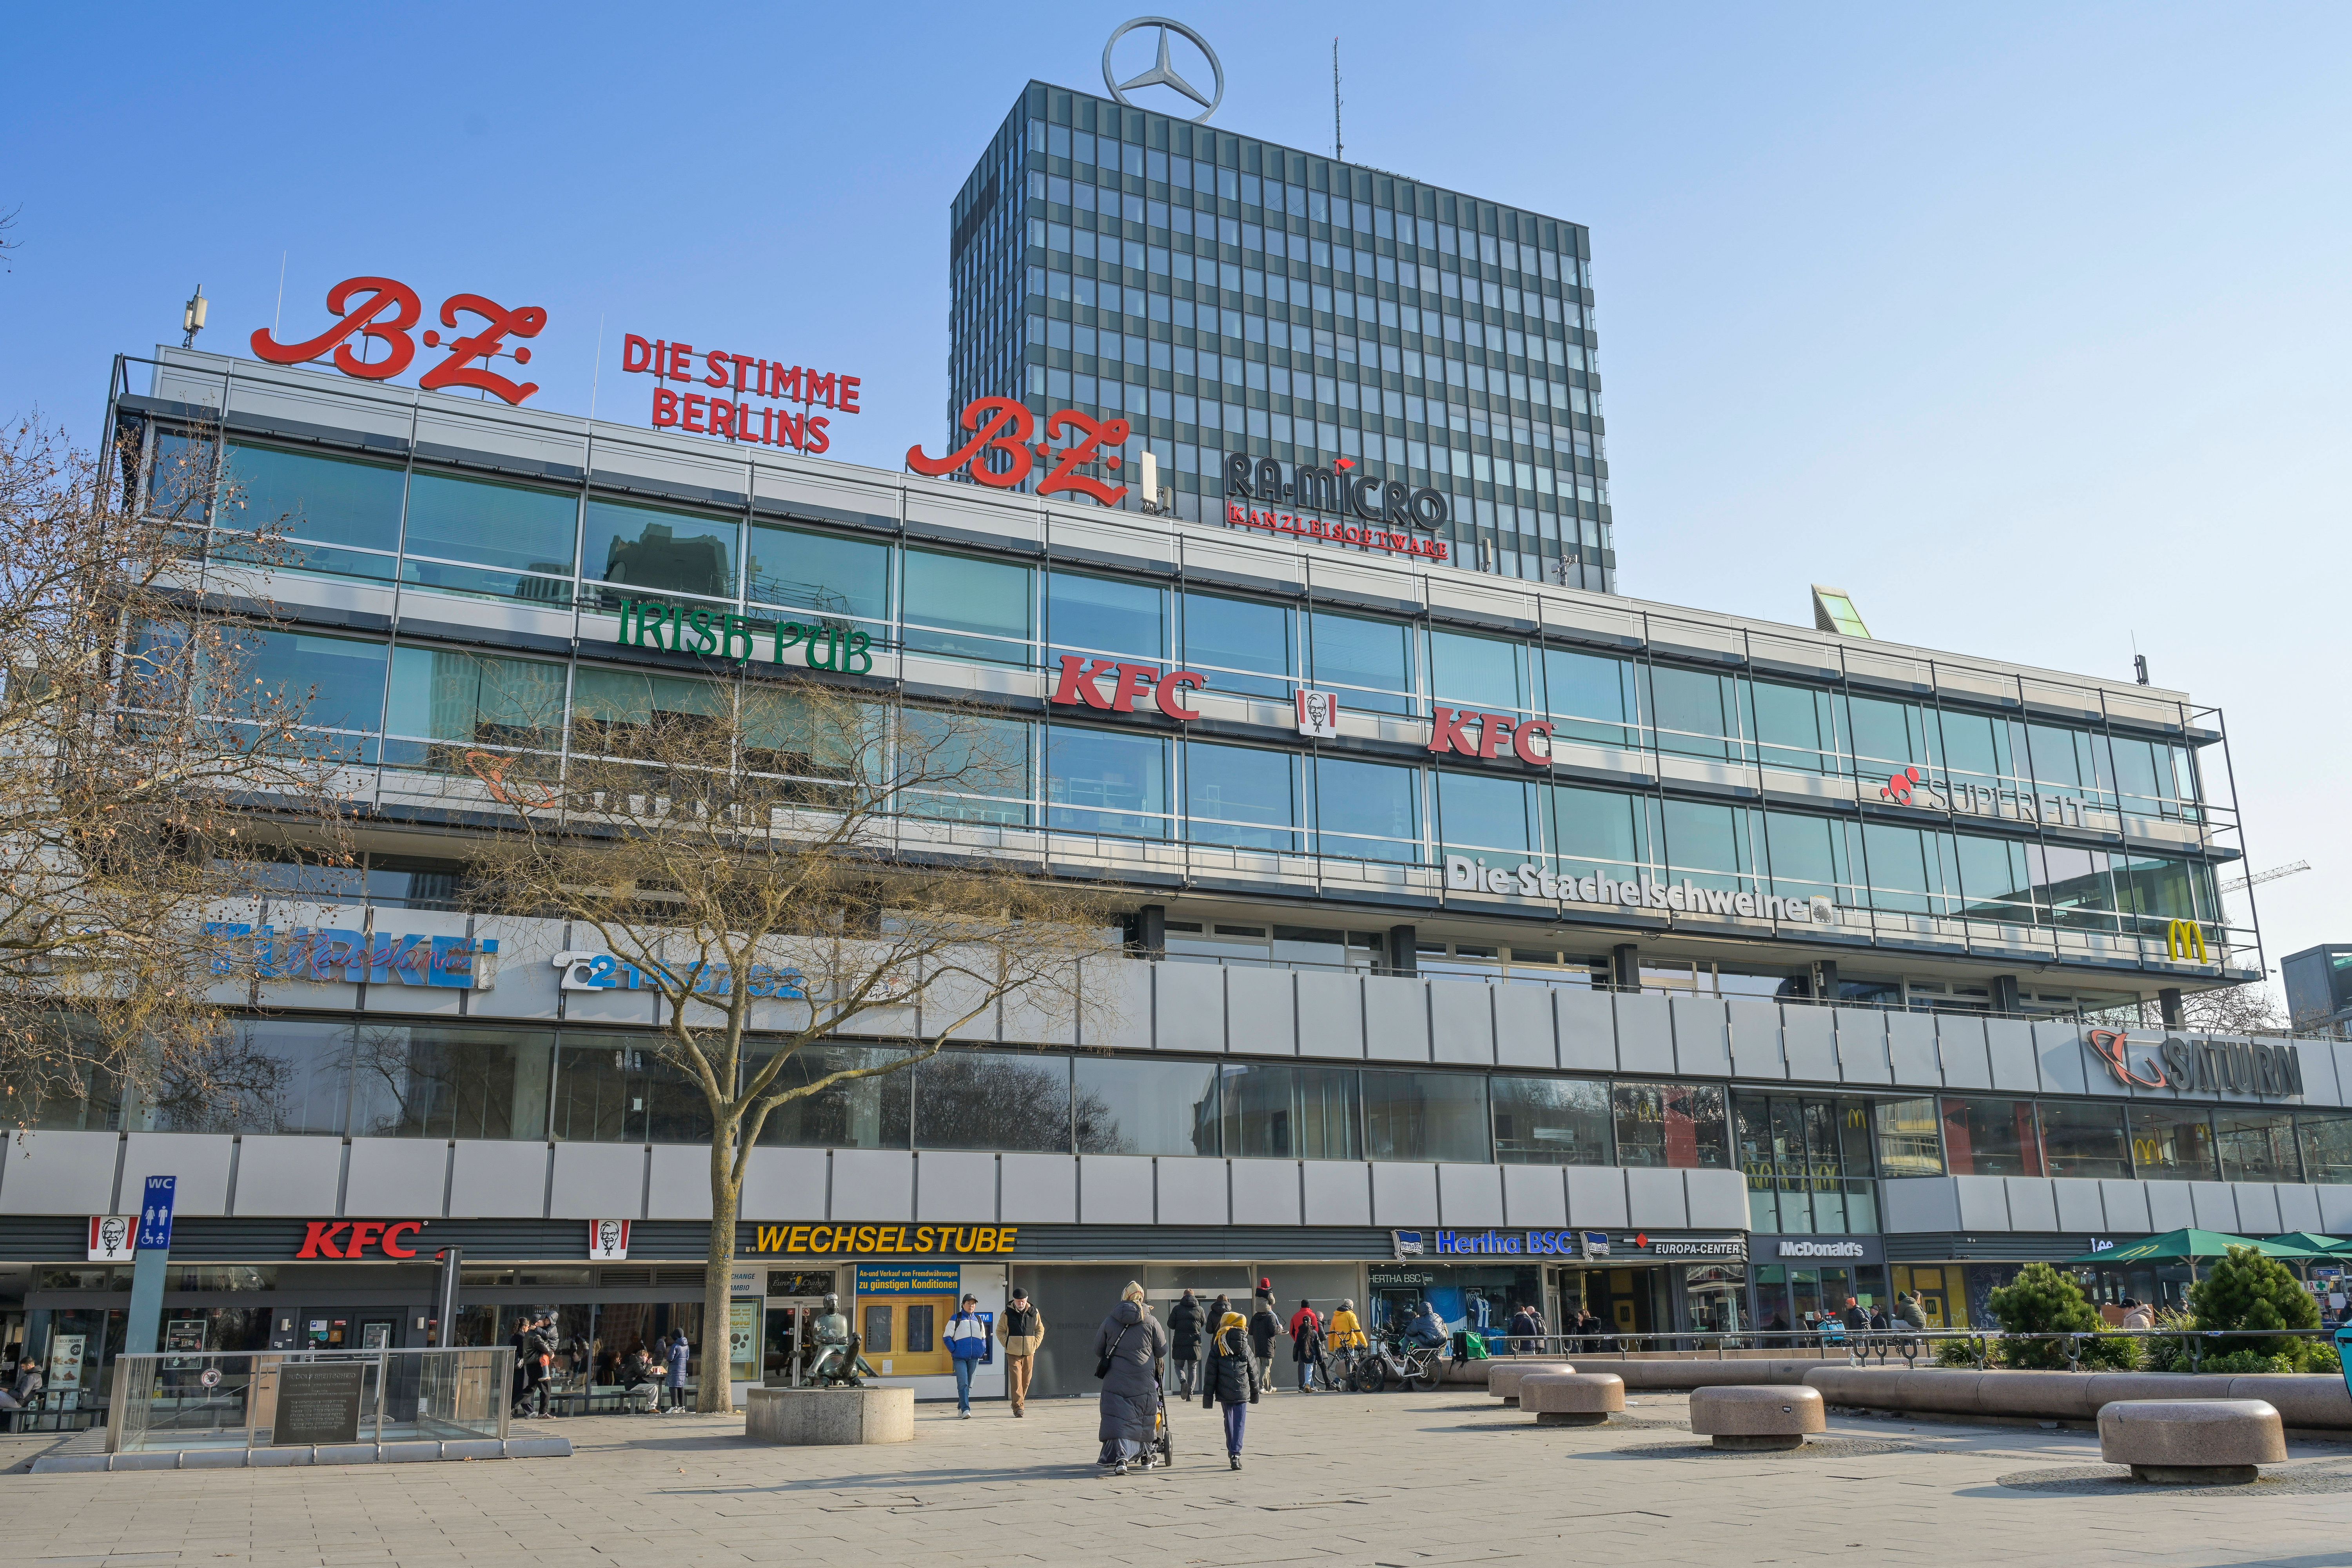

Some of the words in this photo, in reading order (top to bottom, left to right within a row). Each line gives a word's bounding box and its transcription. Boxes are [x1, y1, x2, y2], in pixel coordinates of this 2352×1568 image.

[623, 333, 692, 383] DIE
[704, 350, 861, 414] STIMME
[652, 387, 830, 454] BERLINS
[1230, 505, 1448, 557] KANZLEISOFTWARE
[617, 599, 753, 666] IRISH
[773, 620, 872, 674] PUB
[1928, 777, 2089, 828] SUPERFIT
[1445, 855, 1510, 894] Die
[1517, 863, 1804, 921] Stachelschweine
[2163, 1037, 2304, 1095] SATURN
[148, 1178, 173, 1189] WC
[757, 1226, 1018, 1252] WECHSELSTUBE
[1436, 1230, 1520, 1254] Hertha
[1526, 1231, 1572, 1254] BSC
[1655, 1243, 1740, 1254] EUROPA-CENTER
[1779, 1241, 1863, 1256] McDonald's
[870, 1279, 909, 1291] günstigen
[912, 1279, 957, 1289] Konditionen
[1368, 1274, 1402, 1283] HERTHA
[1404, 1274, 1421, 1283] BSC
